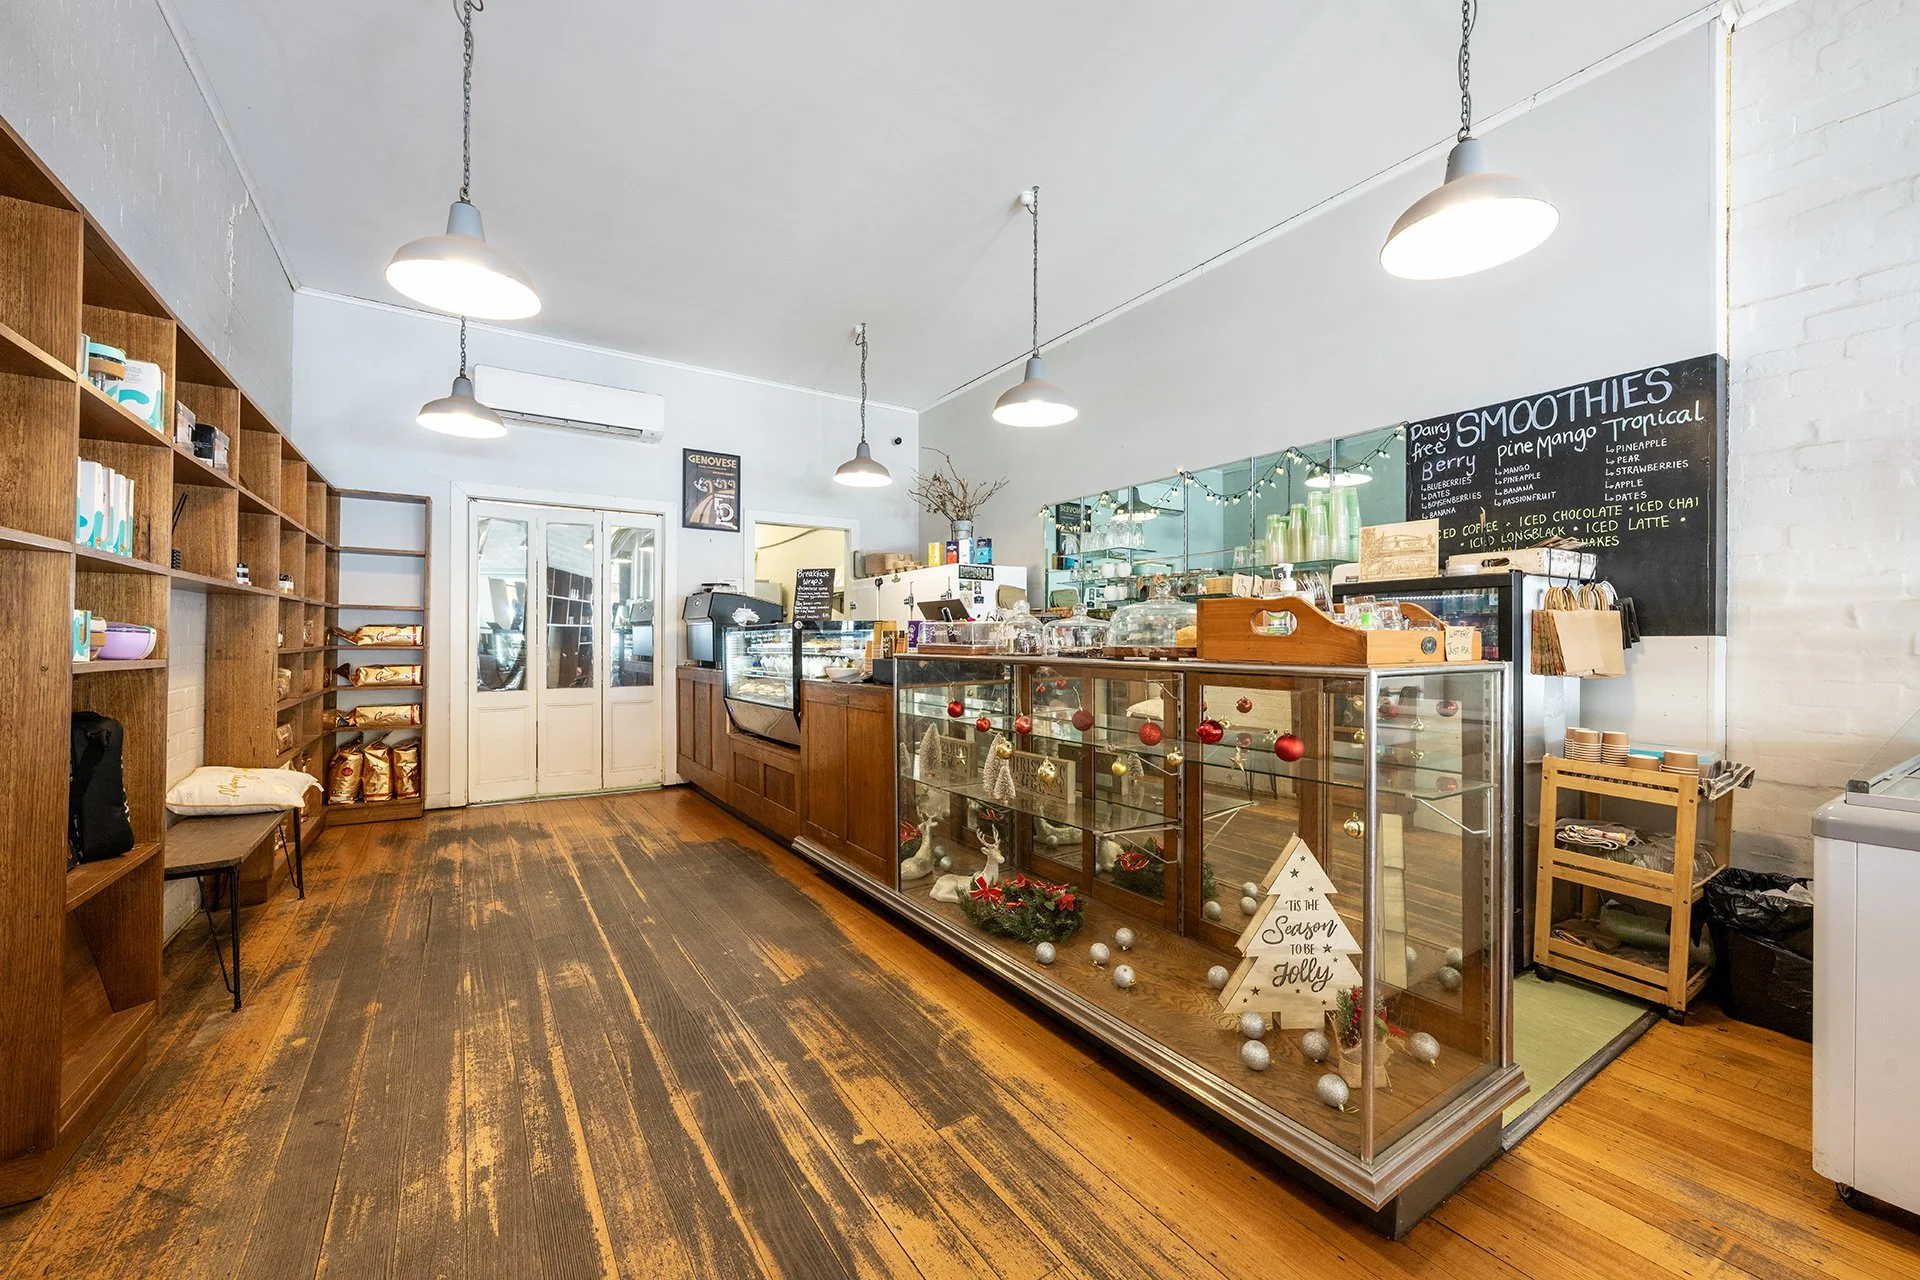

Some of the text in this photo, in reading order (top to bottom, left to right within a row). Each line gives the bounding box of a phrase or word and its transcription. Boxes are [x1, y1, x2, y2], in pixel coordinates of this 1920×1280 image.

[1455, 368, 1673, 448] SMOOTHIES
[1601, 399, 1704, 442] Tropical
[1410, 422, 1451, 442] Dairy
[1411, 441, 1446, 463] free
[1615, 438, 1668, 453] PINEAPPLE
[687, 454, 737, 469] GENOVESE
[1616, 454, 1640, 464] PEAR
[1421, 455, 1476, 481] Berry
[1502, 463, 1531, 475] MANGO
[1615, 459, 1689, 476] STRAWBERRIES
[1426, 476, 1472, 492] BLUEBERRIES
[1502, 472, 1541, 485] PINEAPPLE
[1614, 478, 1644, 490] APPLE
[1427, 489, 1451, 500] DATES
[1503, 483, 1534, 495] BANANA
[1615, 490, 1648, 501] DATES
[1427, 491, 1482, 509] BOYSENBERRIES
[1502, 491, 1557, 506] PASSIONFRUIT
[1429, 506, 1456, 518] BANANA
[1437, 528, 1456, 540] CED
[1519, 513, 1547, 527] ICED
[1552, 504, 1623, 522] CHOCOLATE
[1636, 500, 1664, 513] ICED
[1668, 496, 1699, 509] CHAI
[1586, 520, 1619, 533] ICED
[1628, 515, 1670, 531] LATTE
[1304, 899, 1320, 911] THE
[1261, 915, 1338, 945] Season
[1290, 943, 1316, 956] TO BE
[1272, 957, 1334, 993] Jolly
